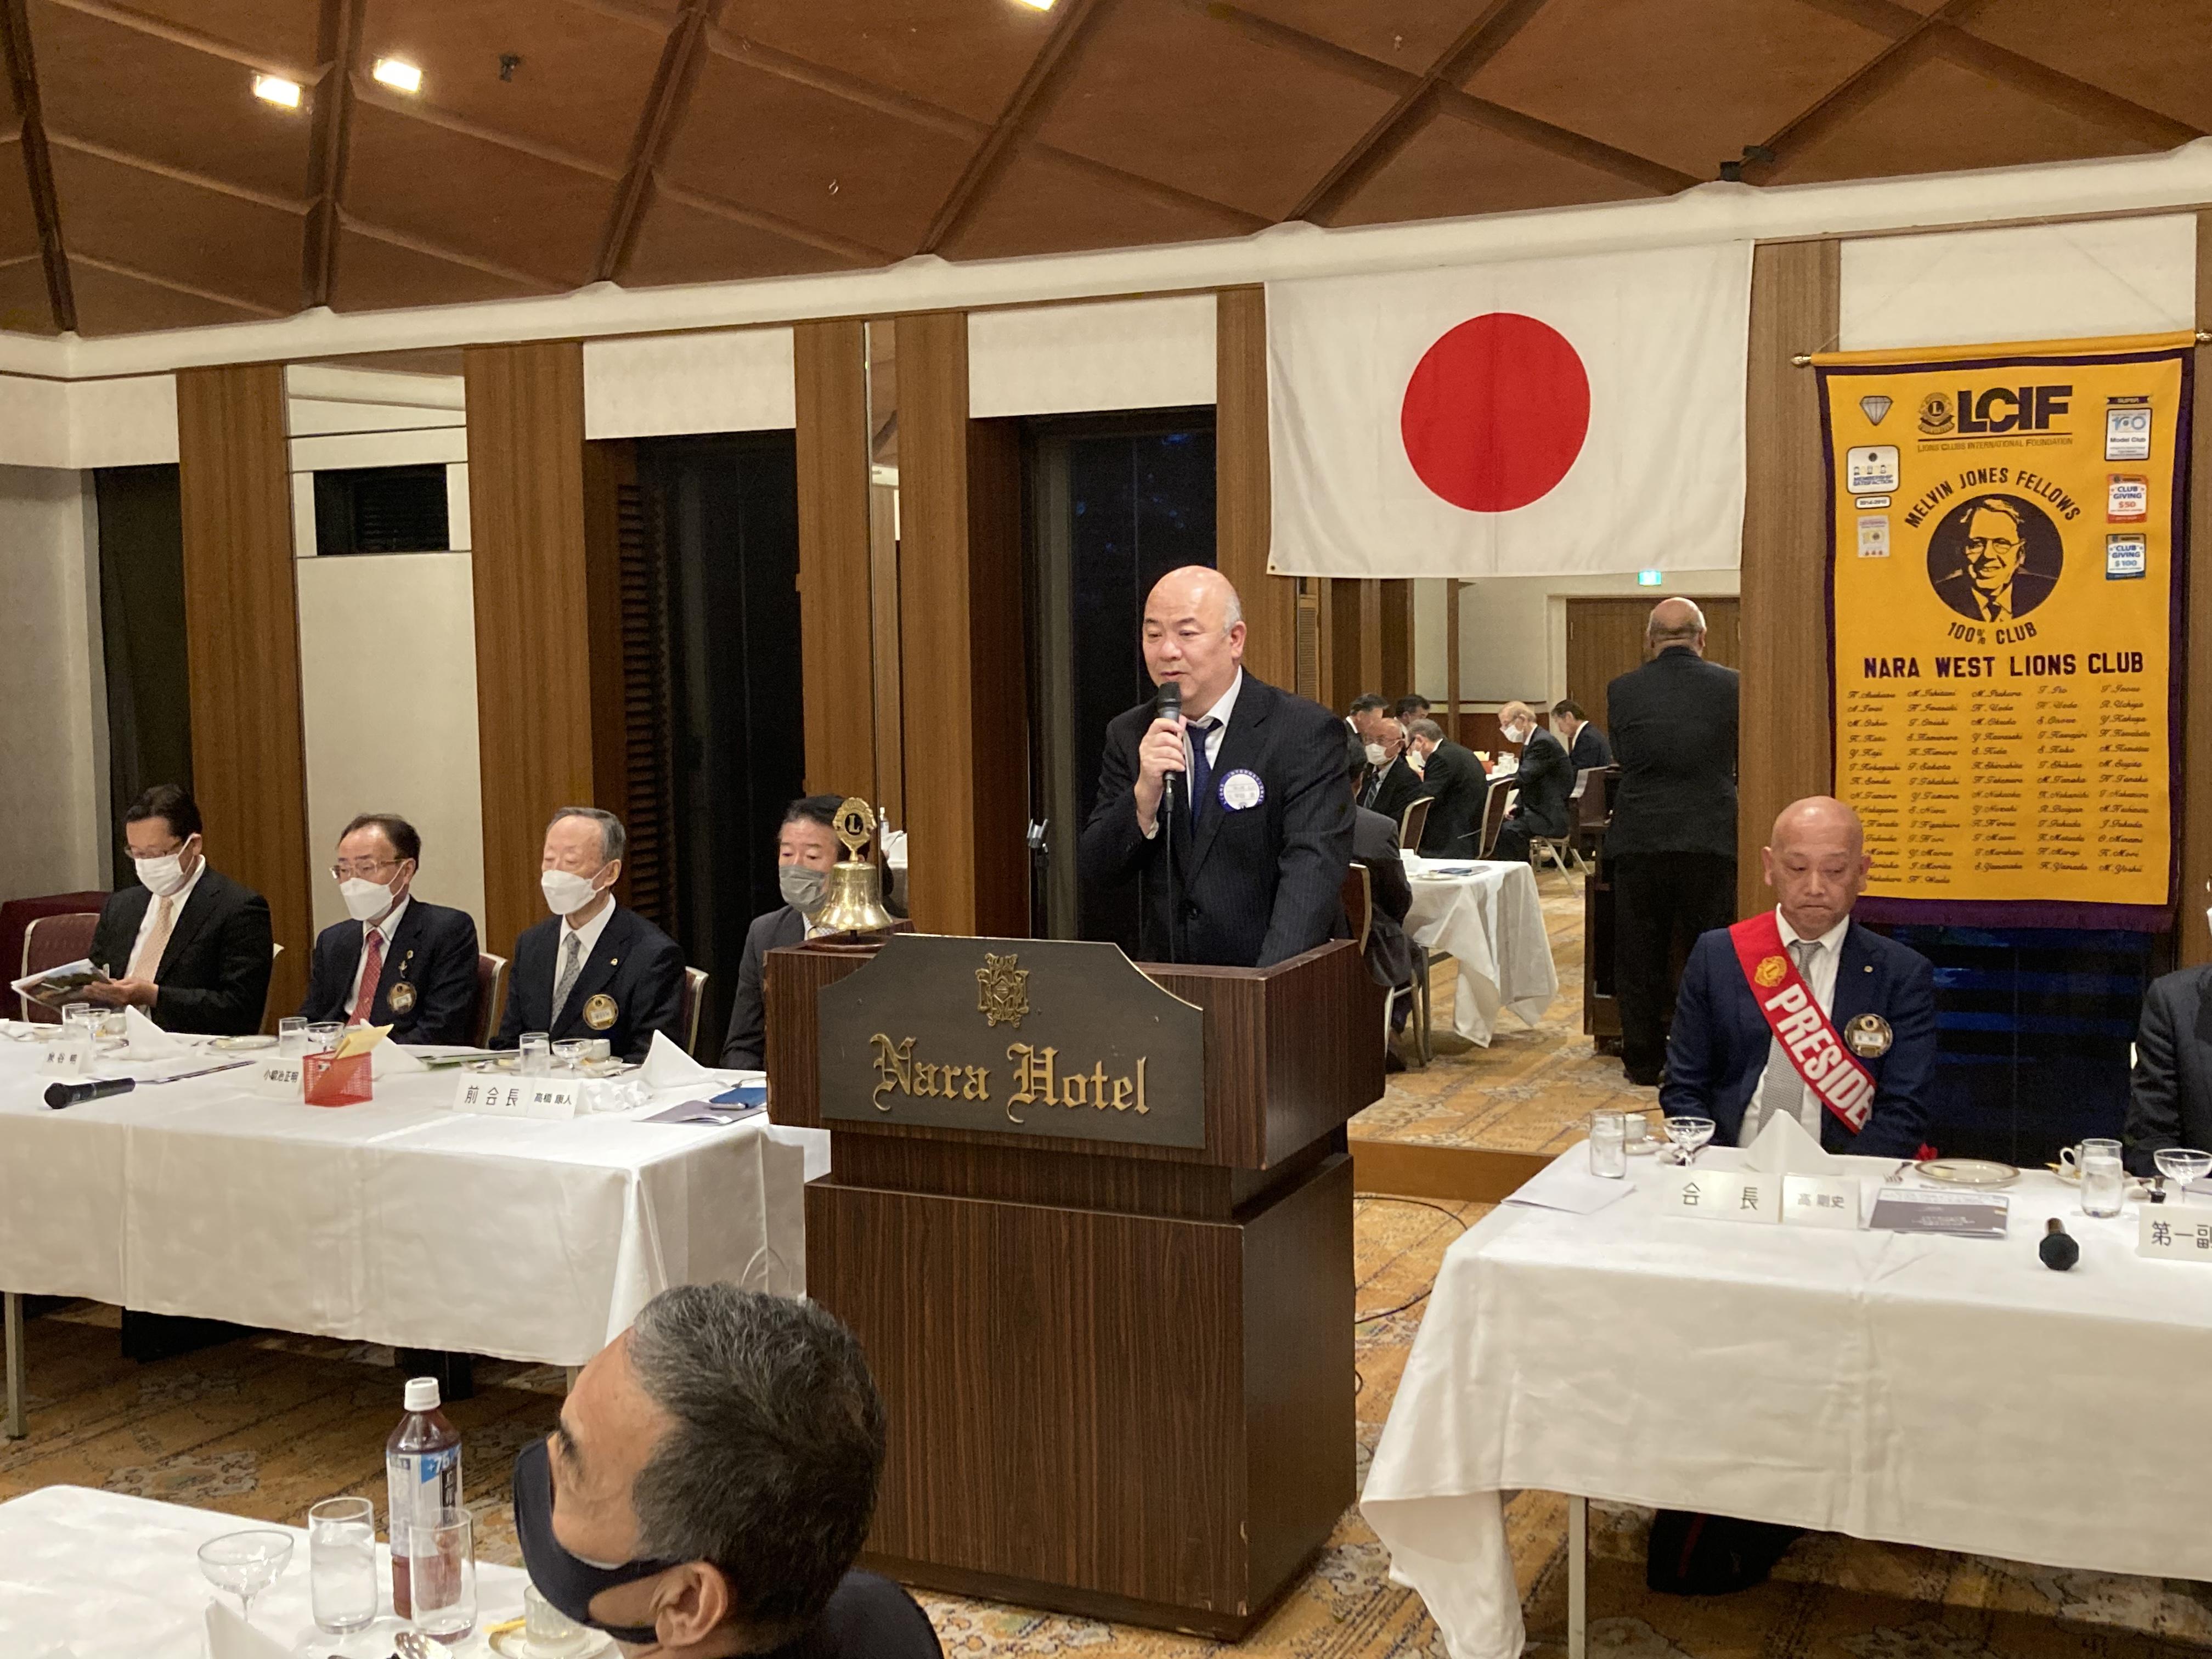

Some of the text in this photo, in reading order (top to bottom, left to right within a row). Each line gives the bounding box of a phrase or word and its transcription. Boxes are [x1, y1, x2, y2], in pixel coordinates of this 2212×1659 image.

[1957, 385, 2073, 433] LCIF
[1904, 467, 2081, 528] MELVIN JONES FELLOWS
[1948, 622, 2038, 645] 100% CLUB
[1864, 651, 2143, 678] NARA WEST LIONS CLUB
[870, 1033, 1150, 1124] Nara Hotel
